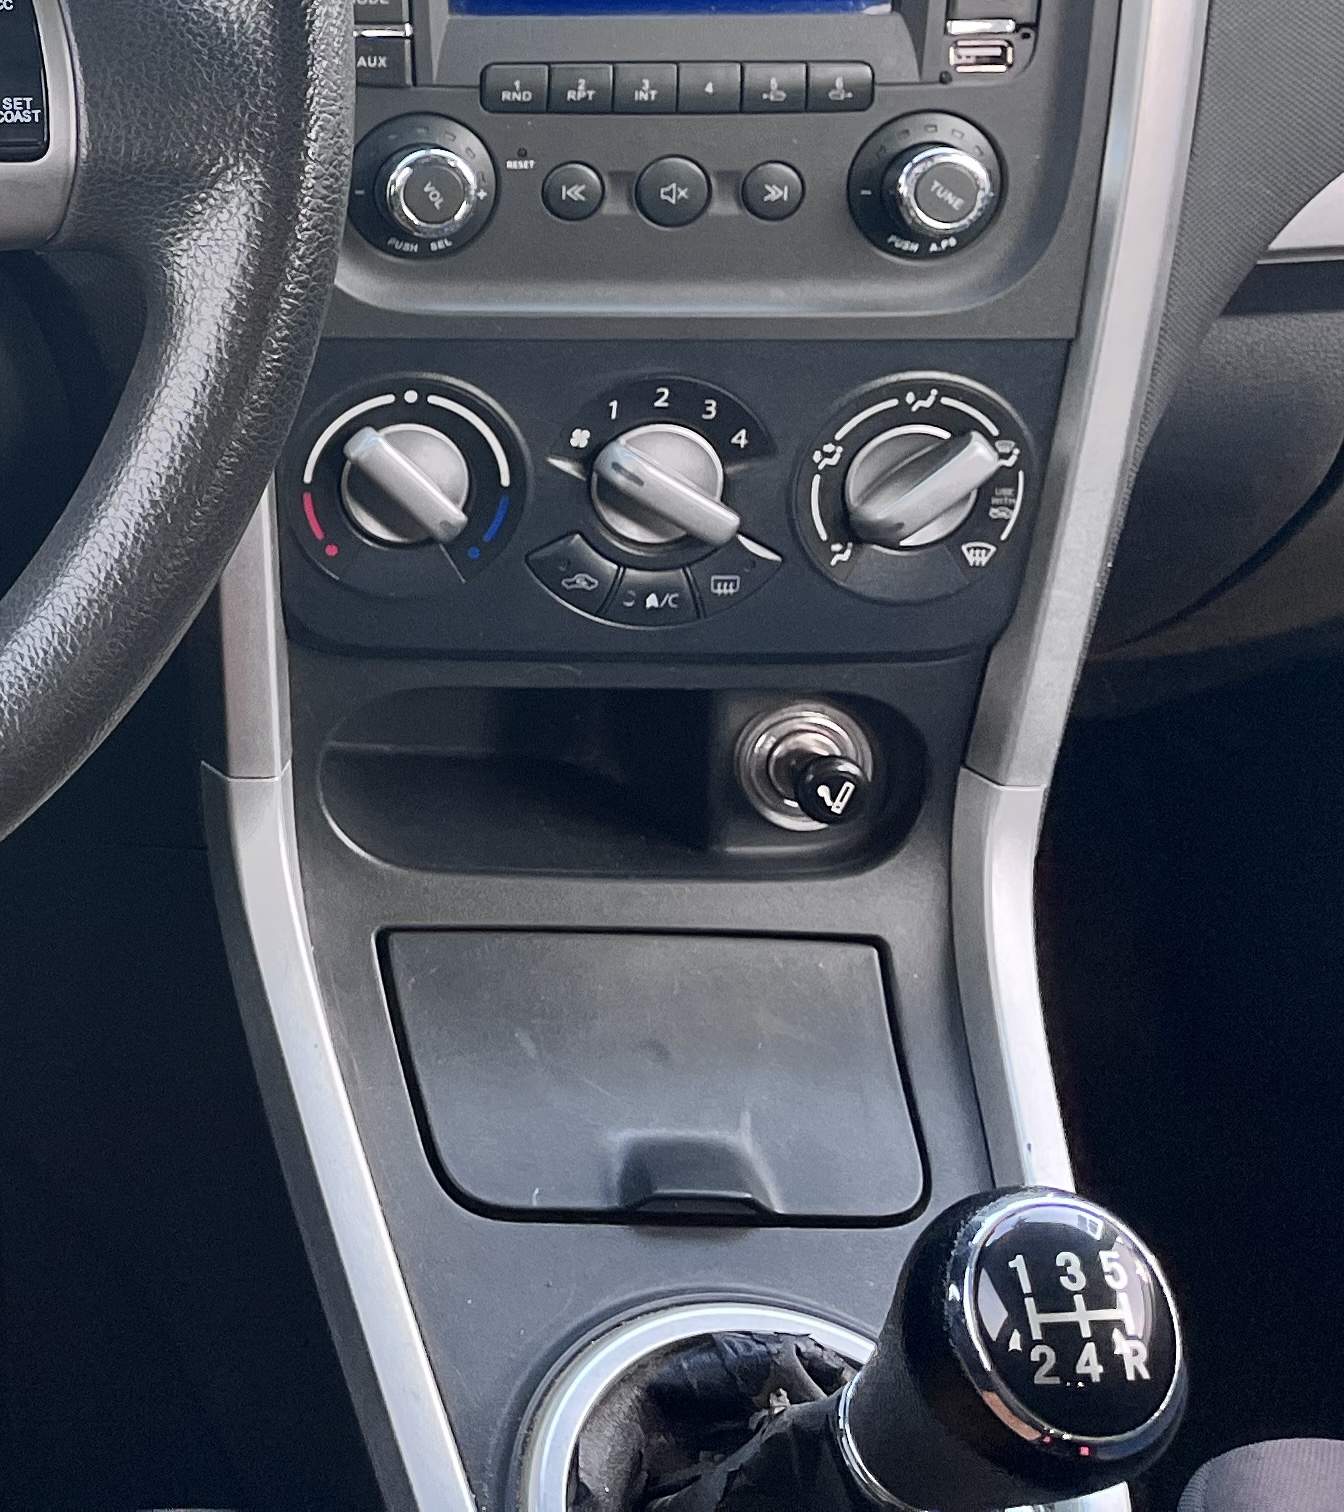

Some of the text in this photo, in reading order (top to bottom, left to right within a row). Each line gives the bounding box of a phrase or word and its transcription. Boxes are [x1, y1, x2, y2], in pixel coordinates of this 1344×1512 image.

[357, 55, 387, 68] AUX
[514, 79, 521, 91] 1
[577, 78, 586, 90] 2
[641, 78, 650, 90] 3
[501, 91, 533, 102] RND
[566, 90, 596, 102] RPT
[634, 90, 658, 101] INT
[2, 97, 33, 111] SET
[506, 160, 536, 170] RESET
[423, 180, 445, 211] VOL
[930, 180, 965, 211] TUNE
[387, 237, 453, 253] PUSH SEL
[887, 234, 920, 253] PUSH
[608, 387, 749, 449] 1 2 3 4
[1008, 1250, 1128, 1294] 1 3 5
[1030, 1340, 1151, 1384] 2 4 R
